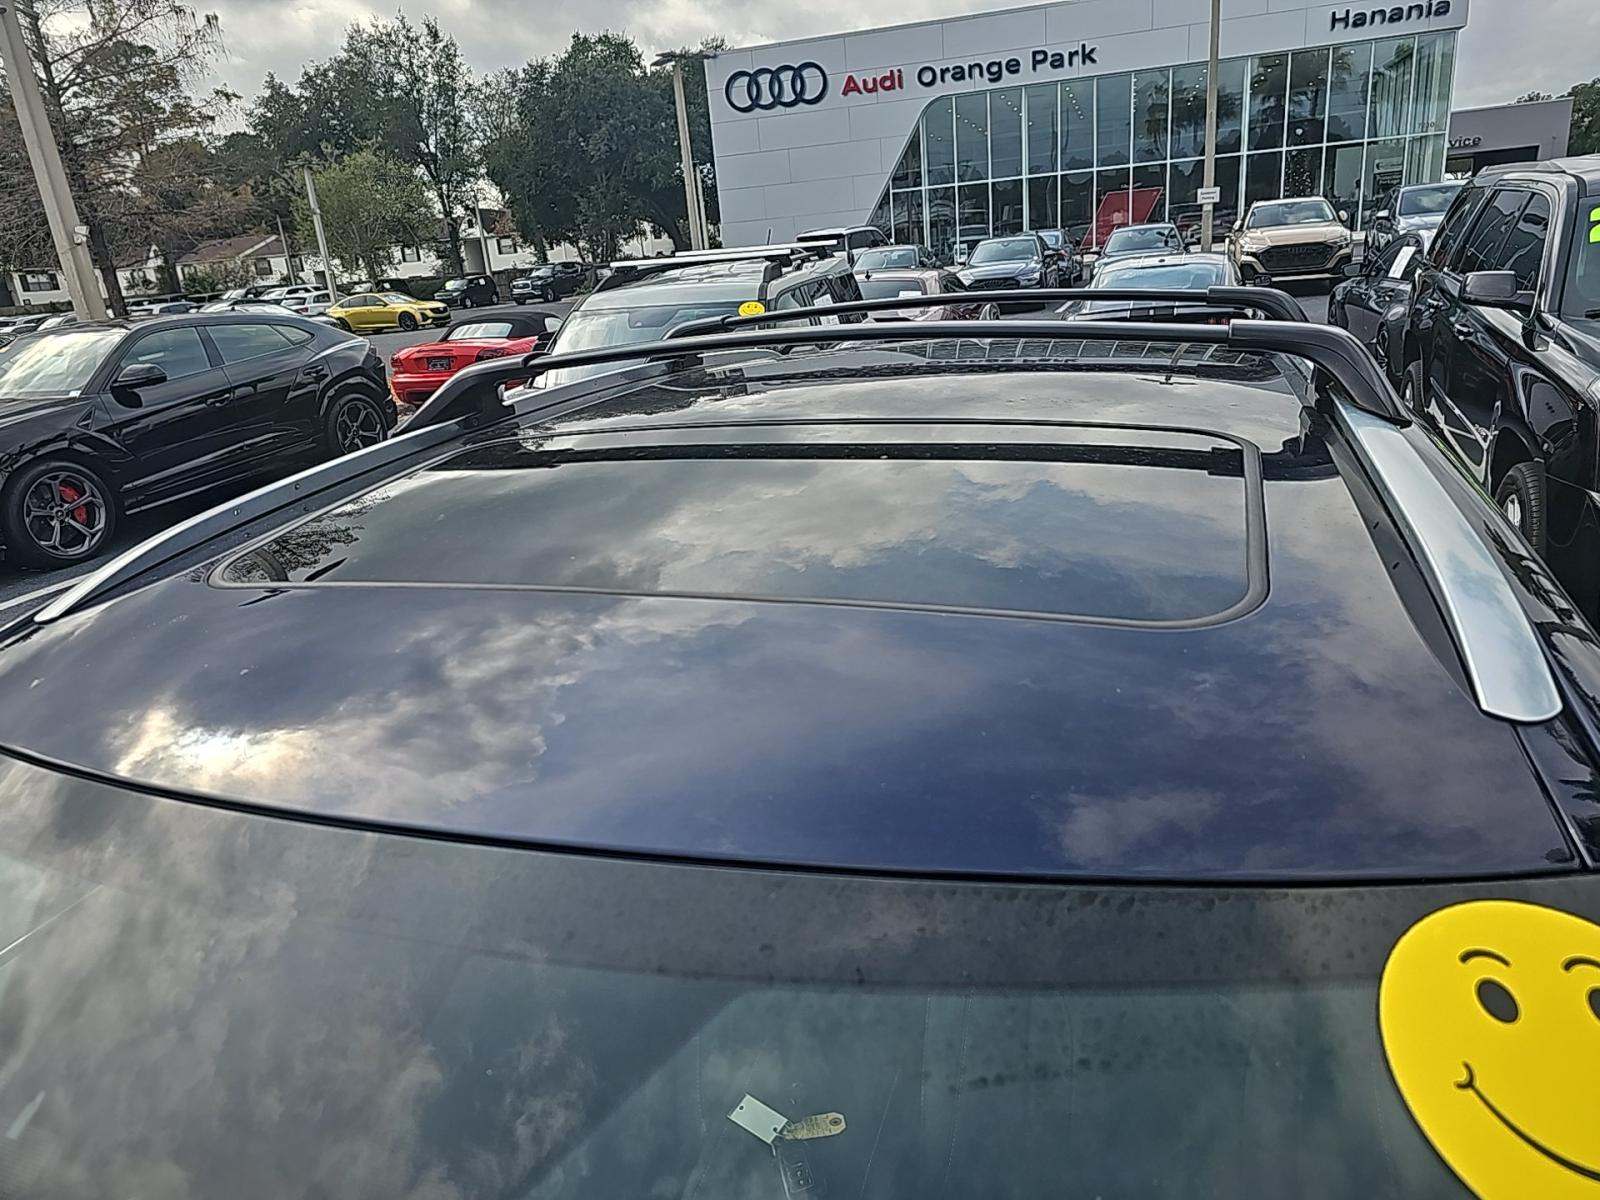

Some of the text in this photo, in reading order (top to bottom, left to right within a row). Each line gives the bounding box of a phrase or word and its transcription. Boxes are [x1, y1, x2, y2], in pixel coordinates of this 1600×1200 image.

[1330, 0, 1451, 31] Hanania
[841, 44, 1098, 97] Audi Orange Park
